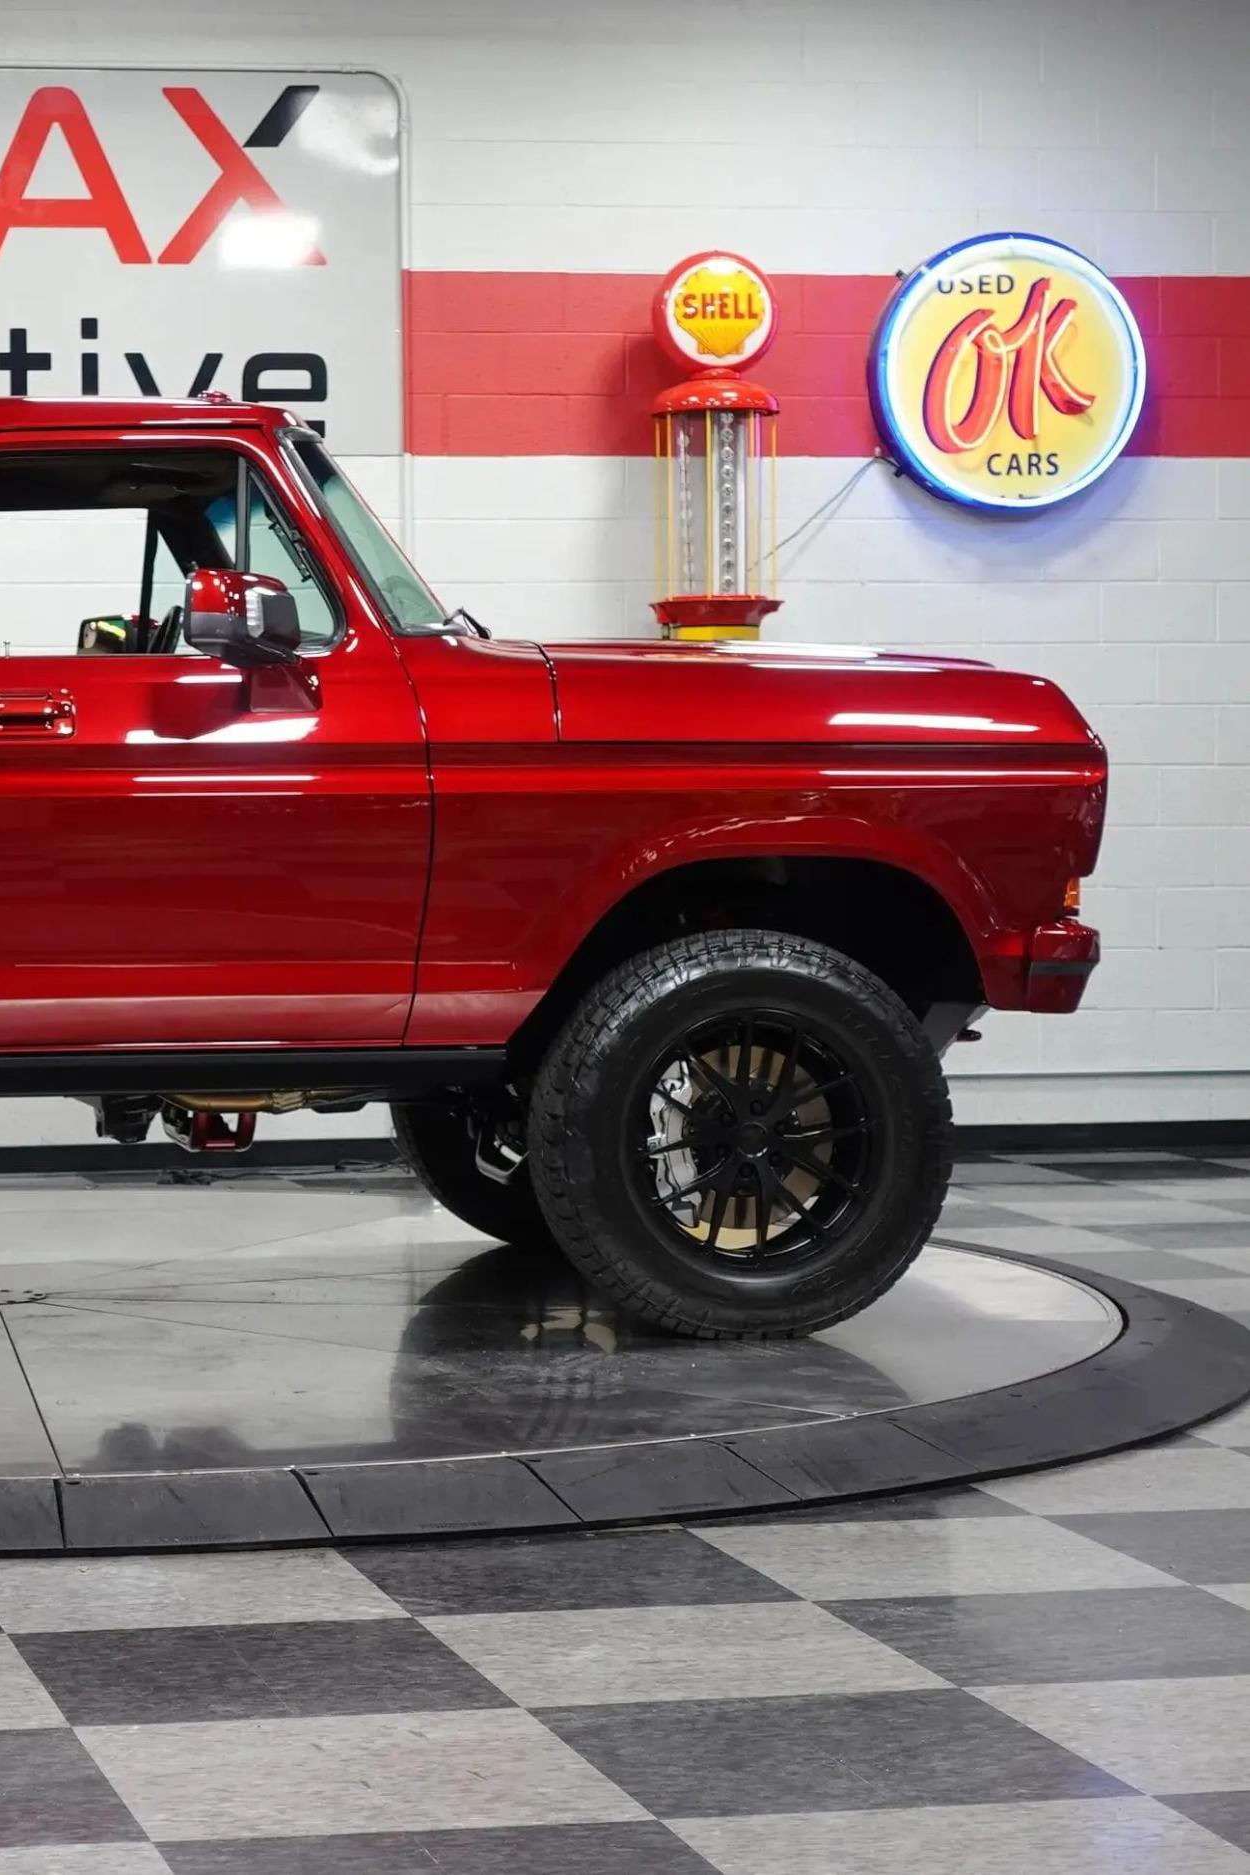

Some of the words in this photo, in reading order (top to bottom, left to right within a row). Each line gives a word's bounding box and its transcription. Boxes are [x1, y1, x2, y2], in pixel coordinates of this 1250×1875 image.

[937, 274, 1015, 294] USED
[682, 293, 759, 320] SHELL
[986, 453, 1059, 476] CARS
